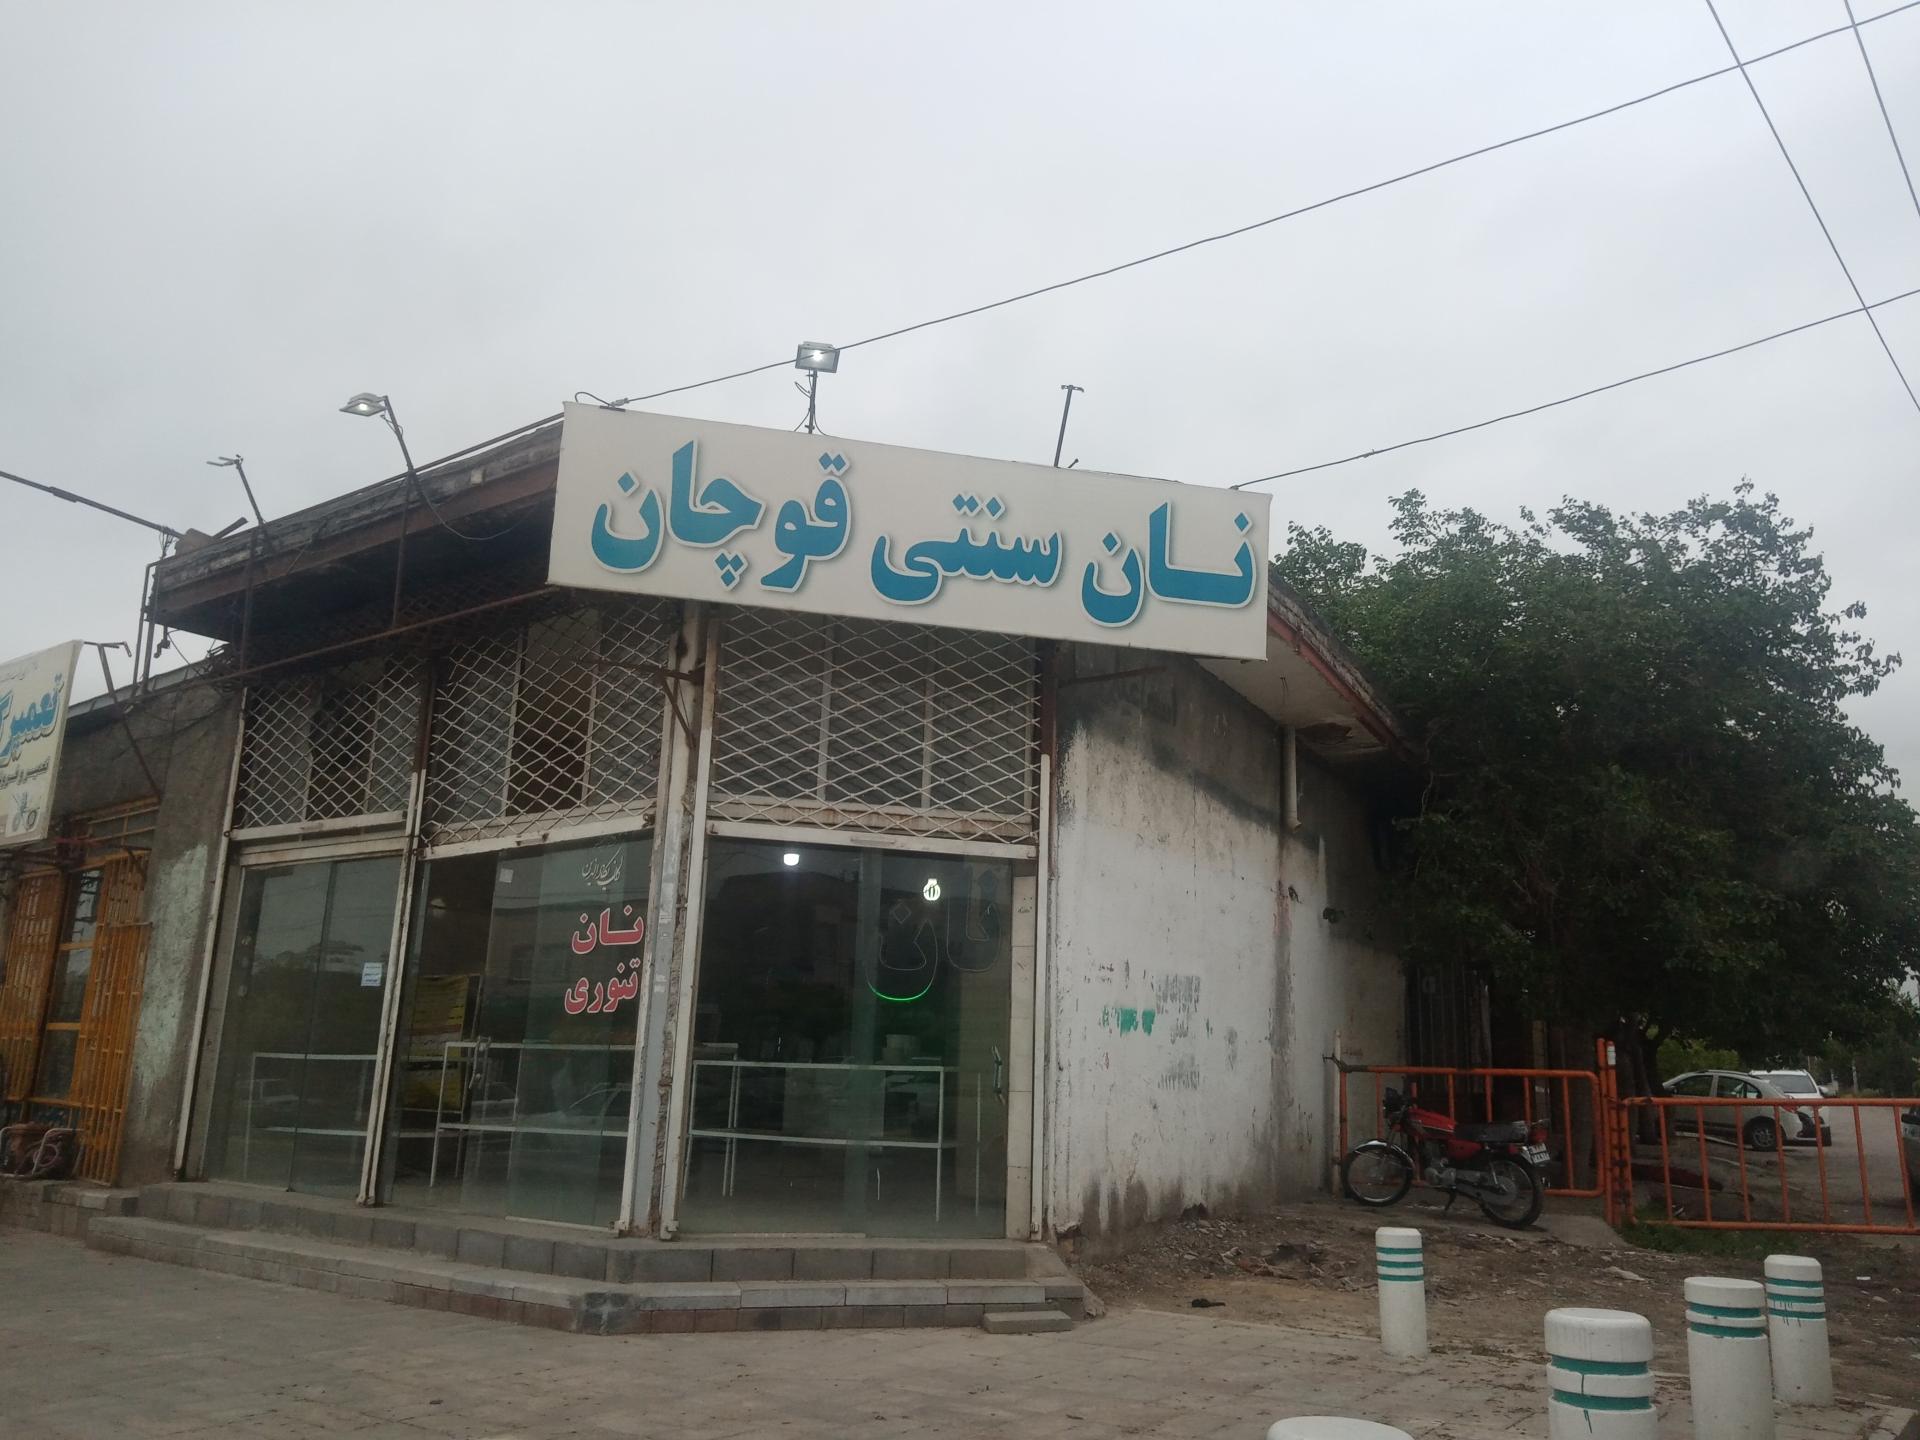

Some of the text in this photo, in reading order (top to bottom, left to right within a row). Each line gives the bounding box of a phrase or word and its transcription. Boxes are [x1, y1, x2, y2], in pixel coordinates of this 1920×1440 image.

[589, 441, 1255, 626] نان سنتی قوچان
[571, 904, 644, 955] نان
[564, 957, 641, 1014] تنوری
